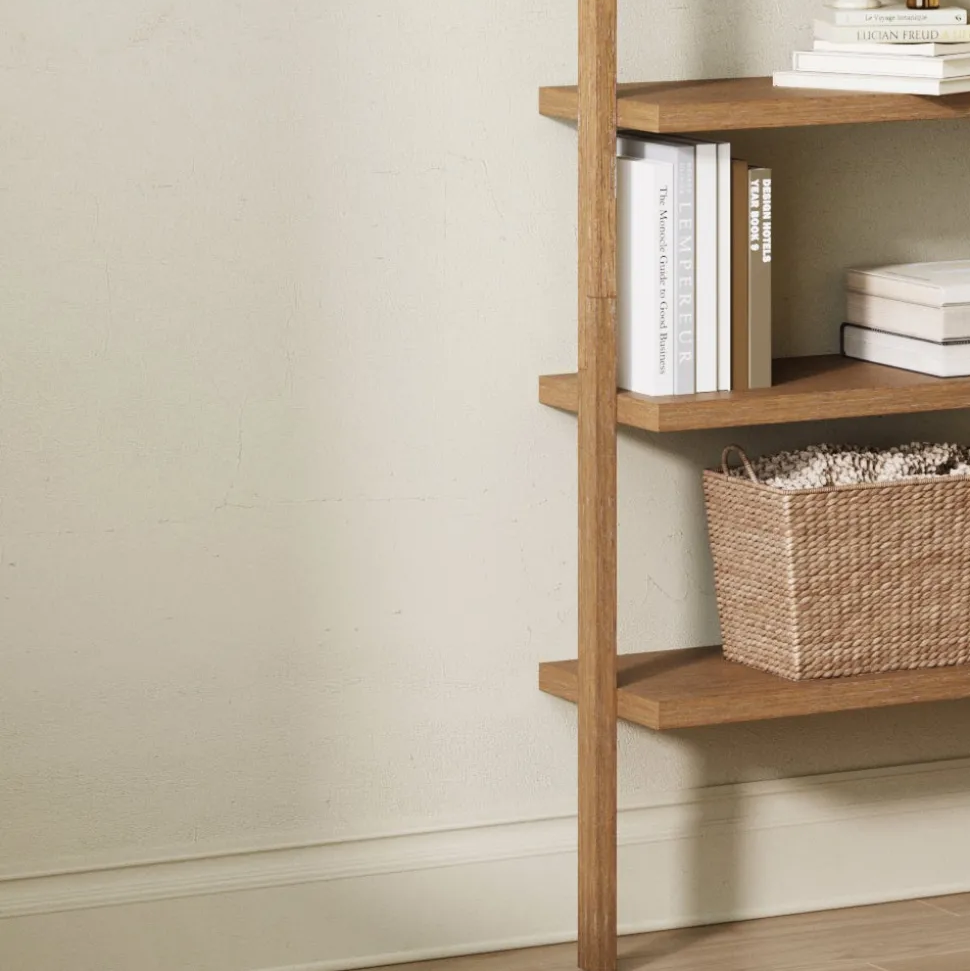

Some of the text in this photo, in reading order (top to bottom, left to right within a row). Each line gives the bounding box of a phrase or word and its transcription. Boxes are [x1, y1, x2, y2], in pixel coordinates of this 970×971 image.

[874, 14, 896, 22] Voyage
[857, 30, 898, 42] LUCIAN
[902, 30, 939, 41] FREUD
[750, 179, 759, 208] YEAR
[750, 211, 759, 240] BOOK
[762, 179, 771, 262] DESIGN HOTELS
[660, 185, 668, 375] The Monocle Guide to Good Business
[679, 202, 692, 365] LEMPEREUR
